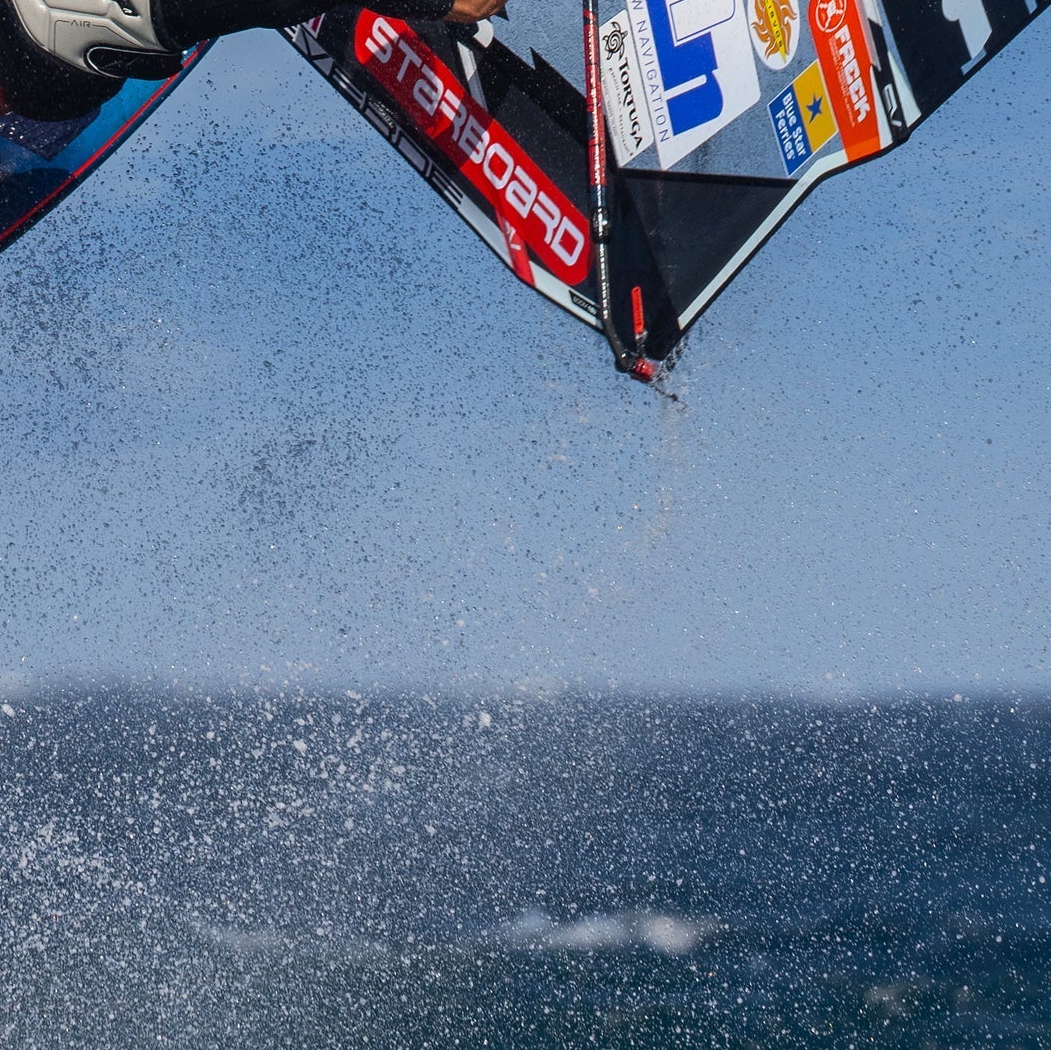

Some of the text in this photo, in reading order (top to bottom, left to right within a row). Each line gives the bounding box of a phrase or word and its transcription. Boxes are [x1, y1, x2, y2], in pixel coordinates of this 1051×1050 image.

[70, 19, 92, 28] AIR
[618, 57, 643, 148] TORTUGA
[636, 20, 670, 143] NAVIGATION
[776, 109, 794, 161] Ferries
[782, 92, 807, 157] Blue Star
